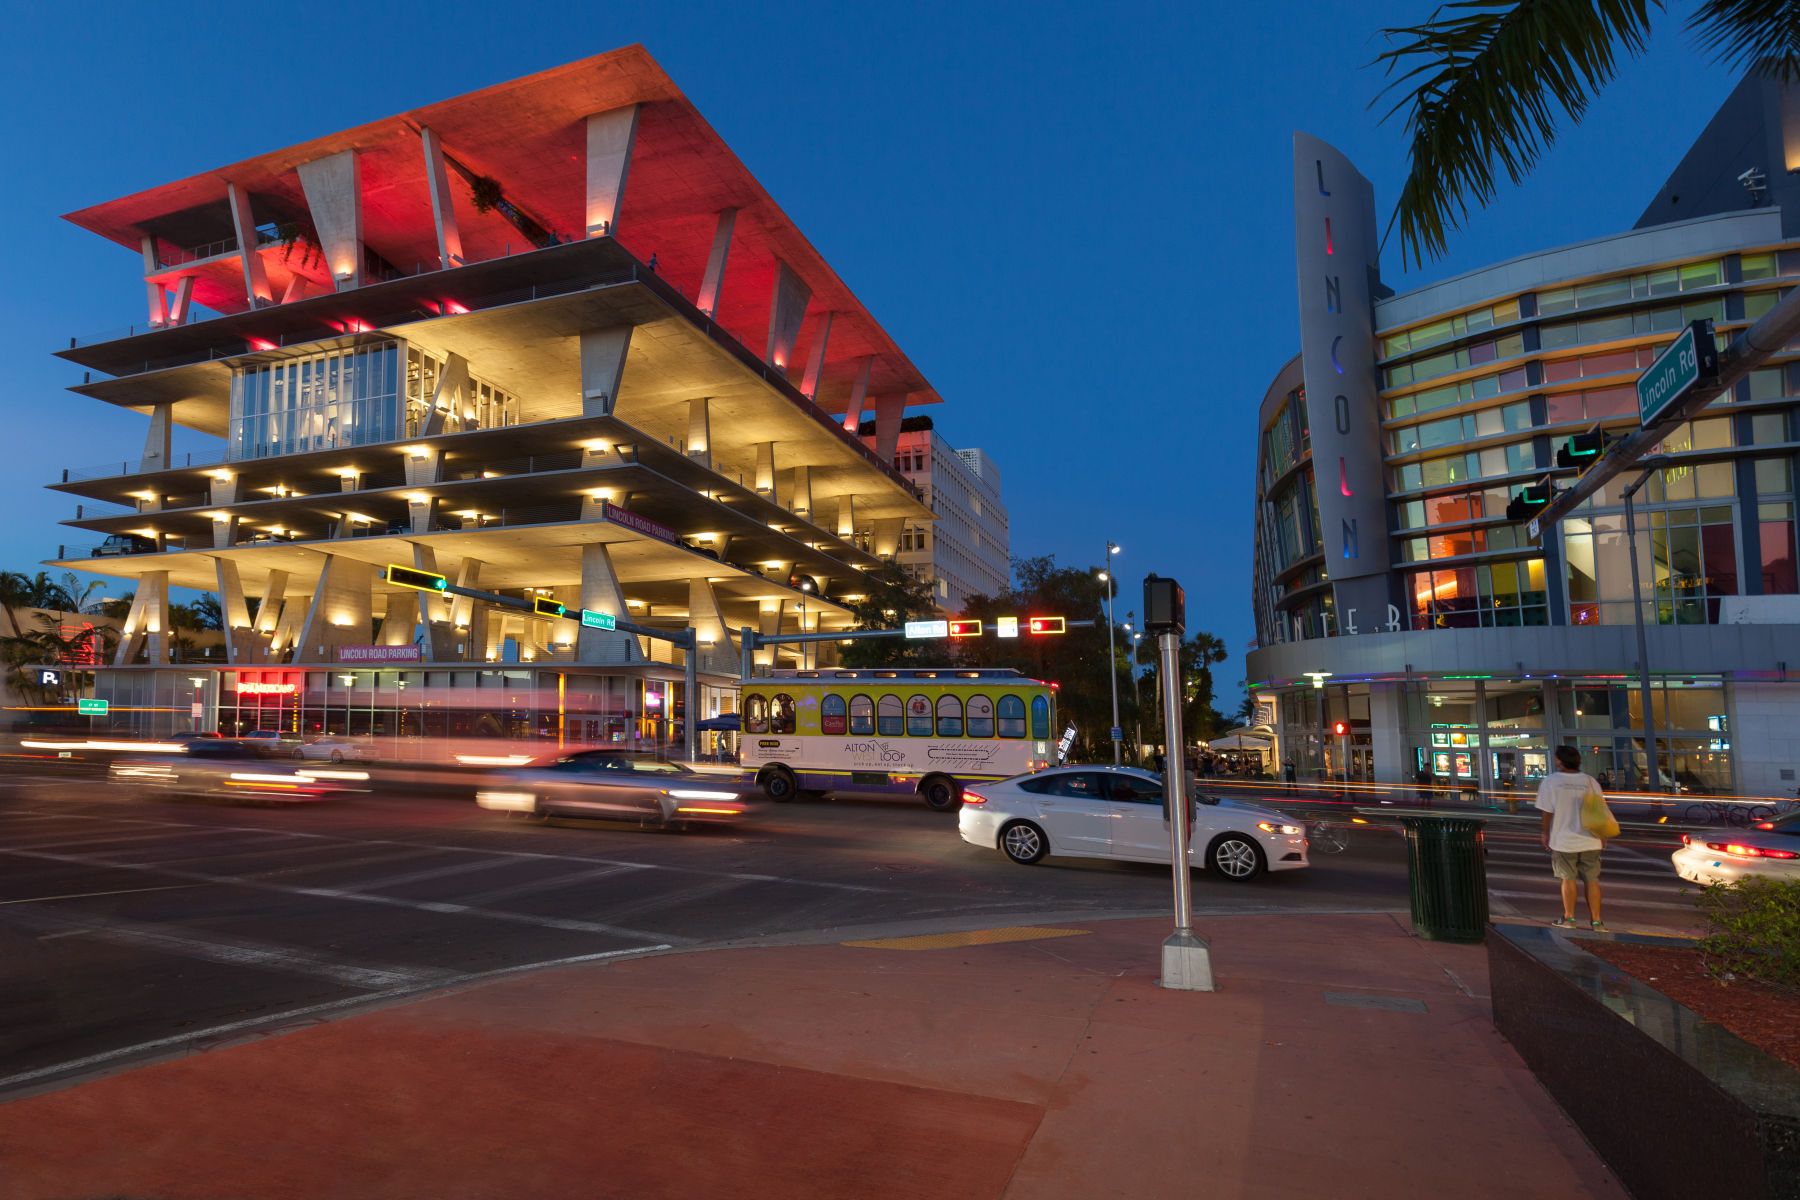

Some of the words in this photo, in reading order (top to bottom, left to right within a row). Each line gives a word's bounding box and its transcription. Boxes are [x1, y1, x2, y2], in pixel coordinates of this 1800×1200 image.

[1315, 159, 1359, 559] LINCOLN
[1640, 366, 1676, 413] Lincoln
[1679, 343, 1695, 375] Rd
[608, 506, 634, 527] LINCOLN
[635, 518, 651, 533] ROAD
[651, 524, 675, 543] PARKING
[583, 613, 605, 625] Lincoln
[606, 618, 615, 627] Rd
[340, 648, 367, 659] LINCOLN
[368, 648, 387, 659] ROAD
[388, 647, 418, 659] PARKING
[844, 743, 875, 753] ALTON
[851, 752, 875, 761] WEST
[880, 752, 906, 761] LOOP
